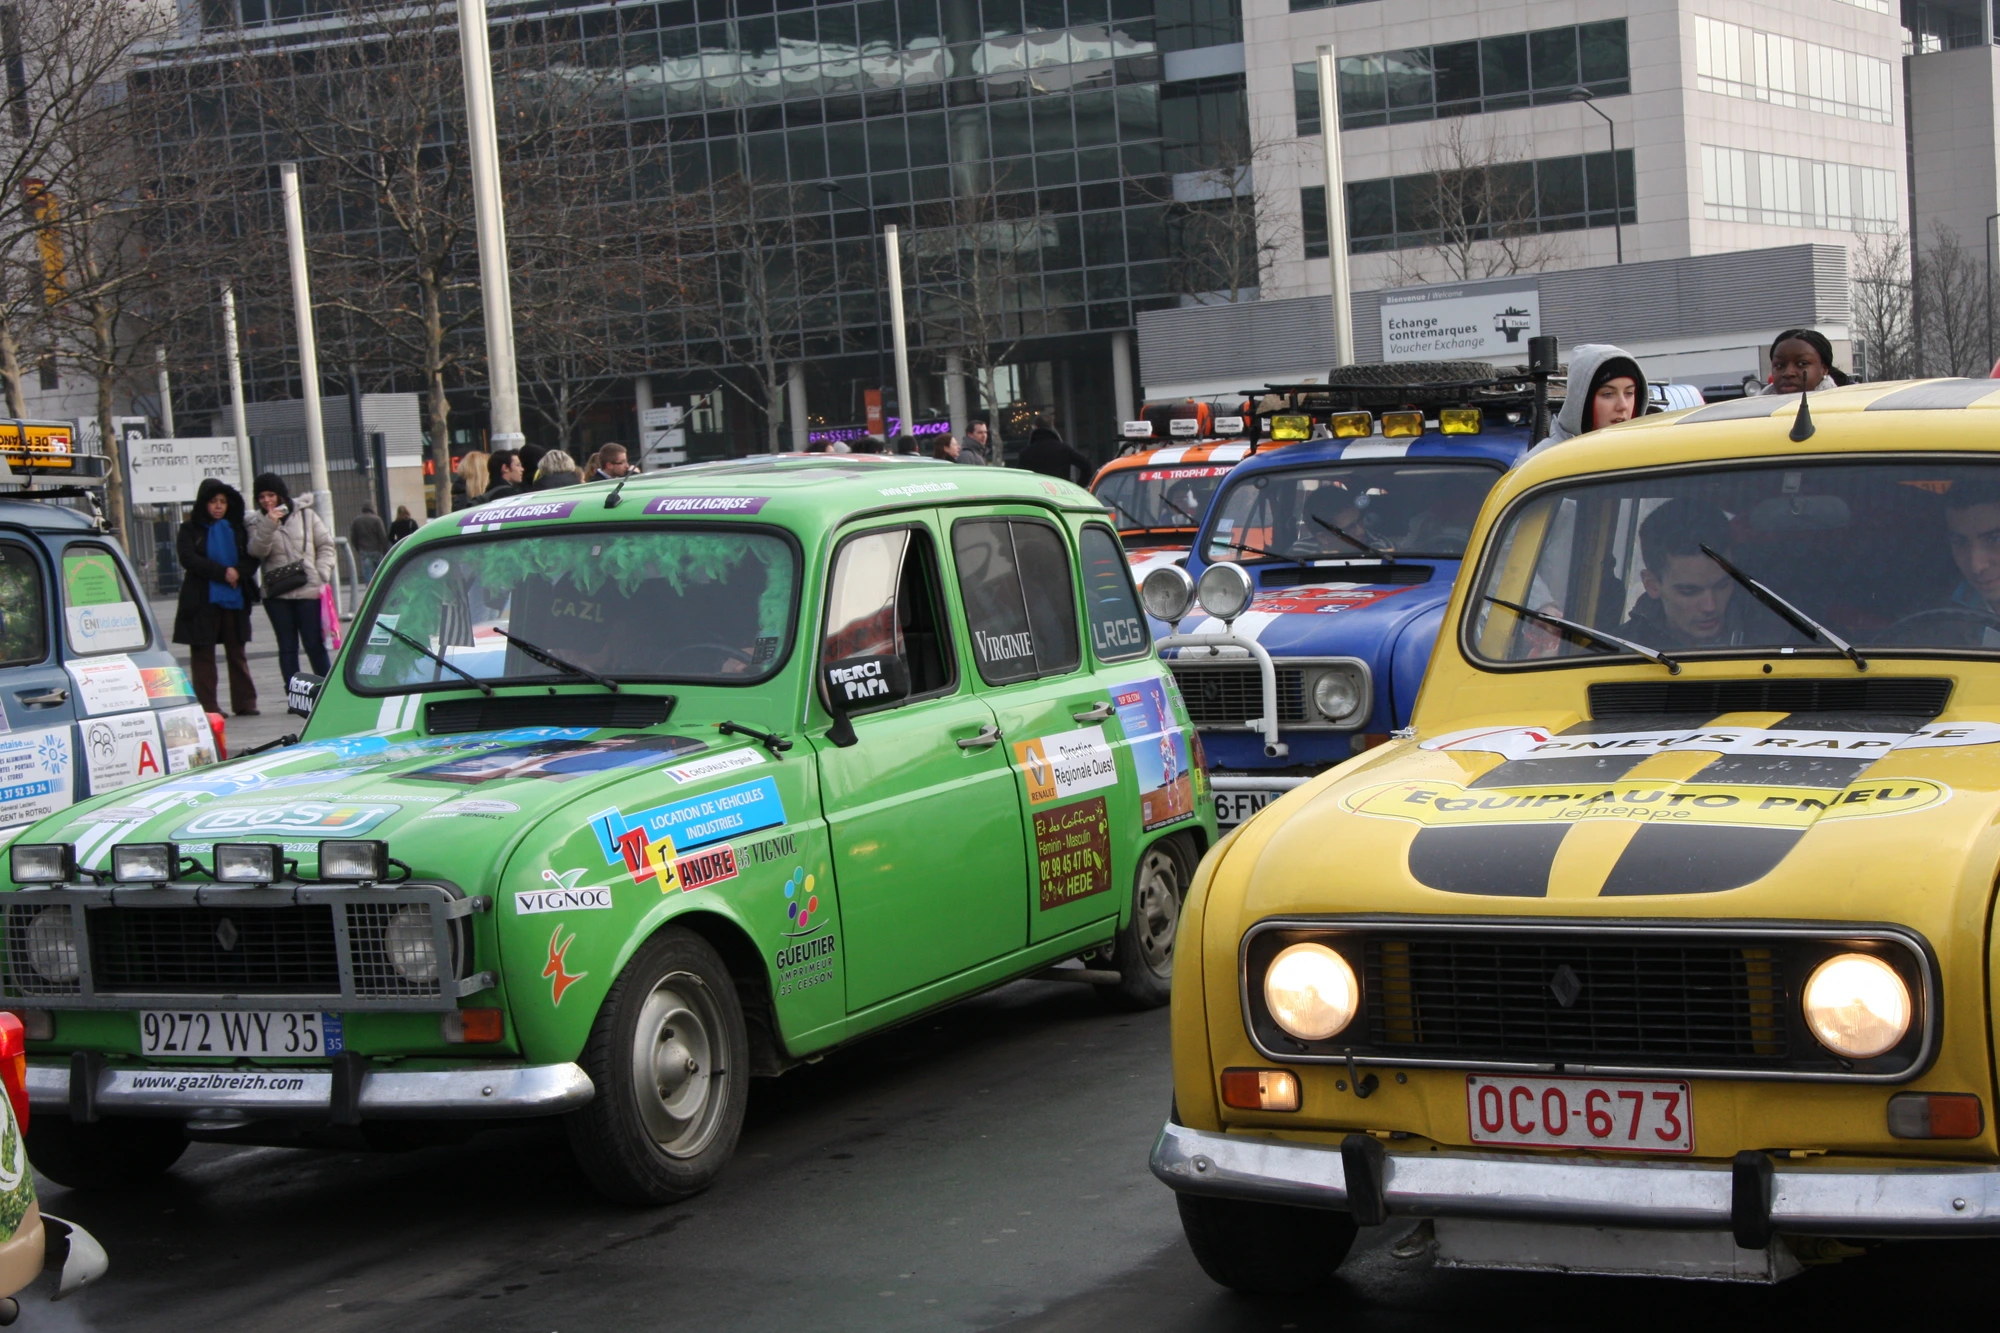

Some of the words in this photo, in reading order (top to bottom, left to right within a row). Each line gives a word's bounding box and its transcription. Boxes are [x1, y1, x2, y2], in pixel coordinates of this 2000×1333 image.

[1386, 294, 1426, 304] Bienvenue
[1431, 290, 1463, 299] Welcome
[1388, 316, 1438, 330] Échange
[1389, 325, 1478, 341] contremarques
[1510, 319, 1529, 327] Ticket
[1390, 341, 1431, 354] Voucher
[1434, 337, 1485, 351] Exchange
[809, 428, 863, 443] BRASSERIE
[886, 416, 950, 438] Fance
[1151, 471, 1163, 480] 4L
[1169, 469, 1208, 479] TROPHY
[470, 501, 564, 524] FUCKLACRISE
[656, 497, 754, 512] FUCKLACRISE
[83, 617, 99, 631] ENI
[1093, 617, 1141, 650] LRCG
[975, 630, 1034, 663] VIRGINIE
[830, 660, 882, 686] MERCI
[844, 678, 890, 700] PAPA
[1060, 741, 1098, 760] Direction
[1527, 734, 1742, 752] PNEUS
[138, 741, 159, 776] A
[689, 761, 728, 777] CHOUPAULT
[729, 756, 753, 769] Virginie
[1054, 761, 1092, 787] Régionale
[1092, 756, 1115, 775] Ouest
[5, 789, 13, 799] 37
[26, 785, 35, 795] 35
[37, 782, 46, 793] 24
[1031, 787, 1055, 801] RENAULT
[1758, 788, 1922, 812] PNEU
[25, 806, 52, 817] ROTROU
[460, 812, 505, 821] RENAULT
[650, 807, 701, 831] LOCATION
[701, 801, 716, 816] DE
[714, 788, 765, 812] VEHICULES
[1547, 803, 1692, 821] Jemeppe
[686, 813, 744, 840] INDUSTRIELS
[737, 846, 751, 870] 35
[752, 833, 798, 864] VIGNOC
[1038, 838, 1062, 856] Féminin
[1066, 829, 1091, 849] Masculin
[680, 850, 735, 888] ANDRE
[1040, 860, 1050, 880] 02
[1051, 857, 1061, 878] 99
[1062, 853, 1072, 874] 45
[1073, 851, 1081, 871] 47
[1083, 847, 1092, 868] 05
[1066, 870, 1093, 897] HEDE
[518, 889, 611, 911] VIGNOC
[776, 934, 836, 970] GUEUTIER
[780, 956, 832, 983] IMPRIMEUR
[781, 984, 792, 996] 35
[797, 970, 833, 990] CESSON
[144, 1013, 212, 1052] 9272
[221, 1013, 272, 1052] WY
[283, 1013, 319, 1053] 35
[327, 1037, 343, 1051] 35
[132, 1073, 304, 1092] www.gazlbreizh.com
